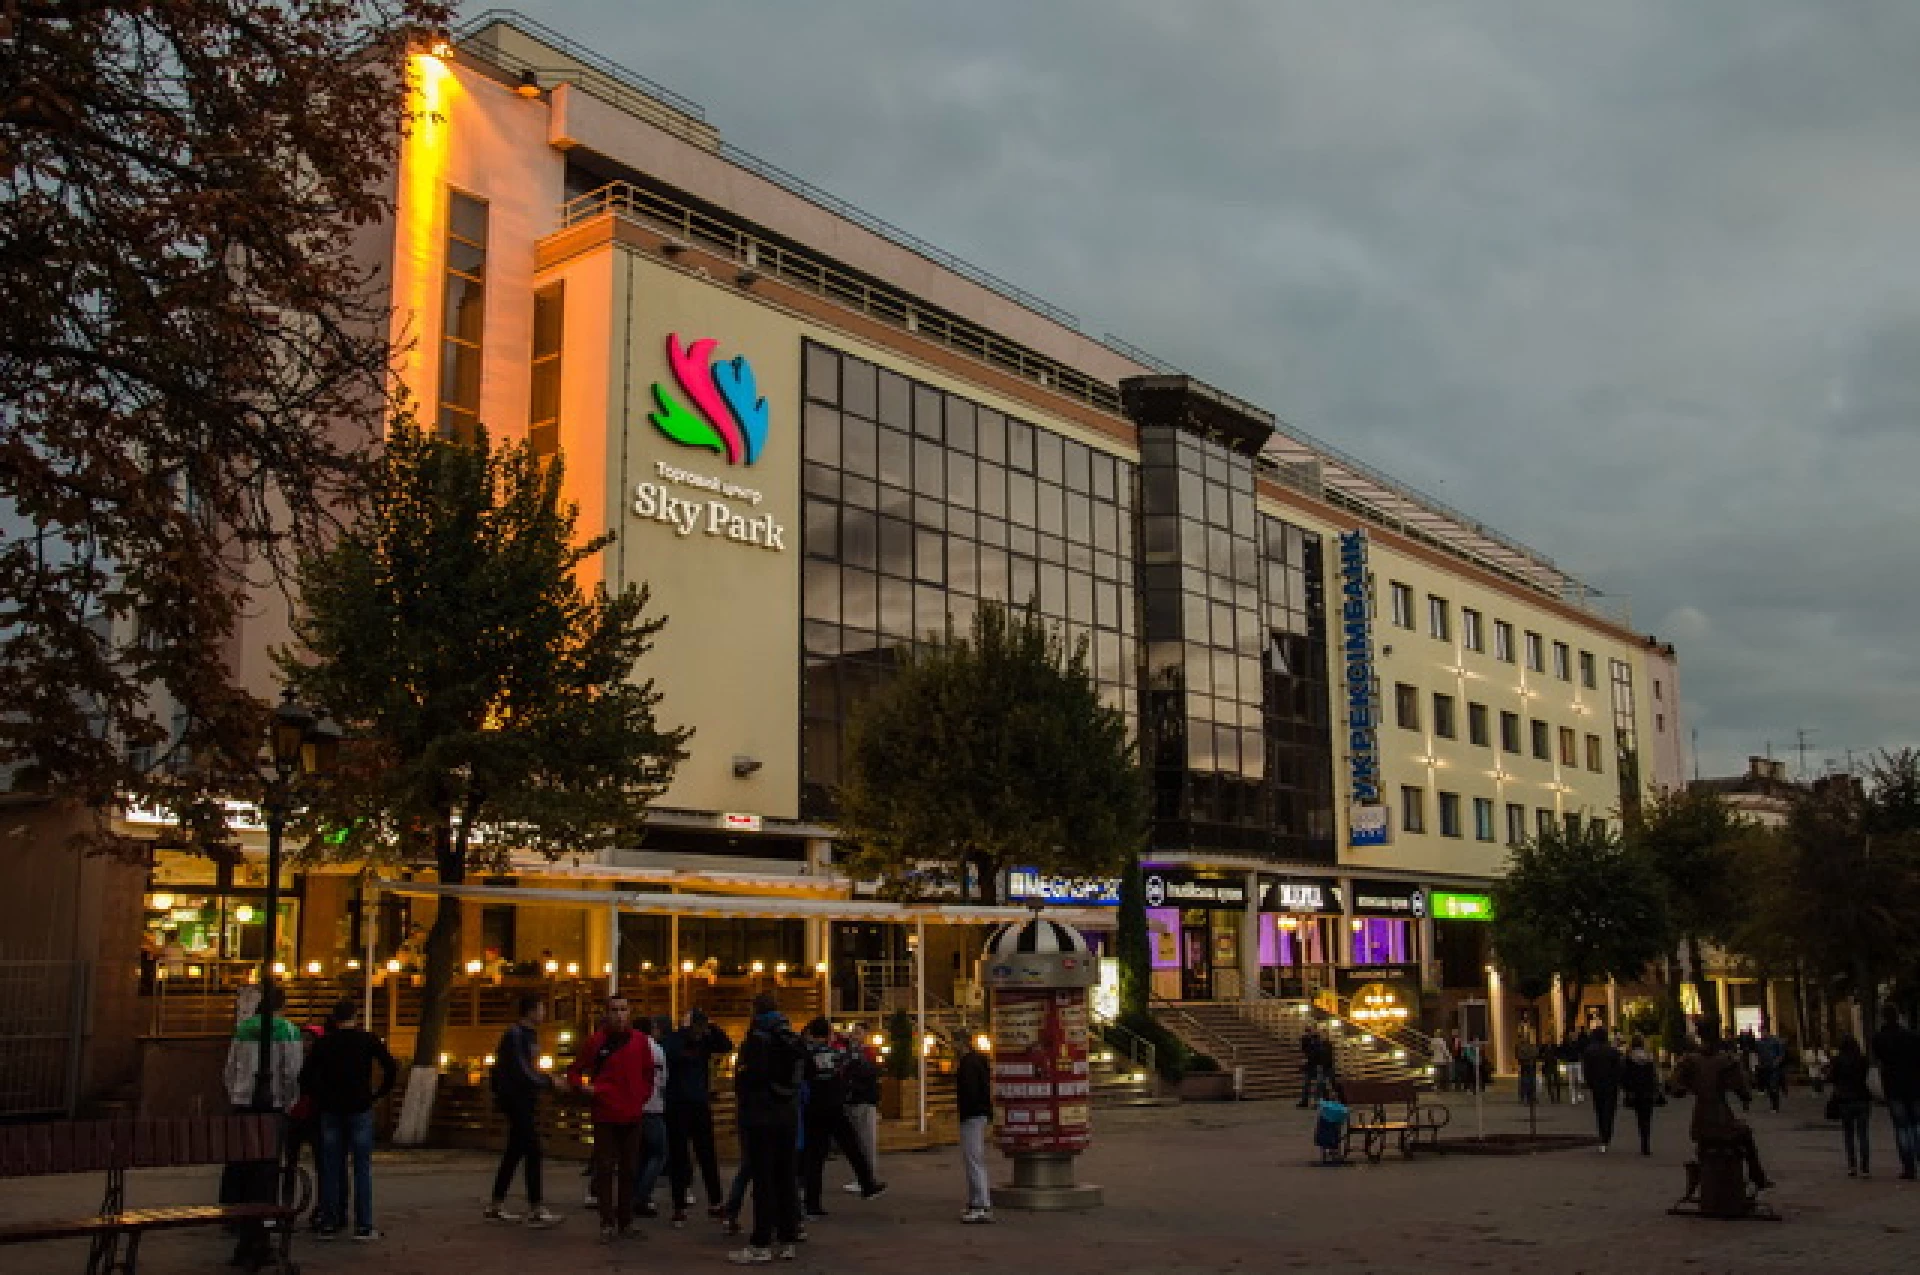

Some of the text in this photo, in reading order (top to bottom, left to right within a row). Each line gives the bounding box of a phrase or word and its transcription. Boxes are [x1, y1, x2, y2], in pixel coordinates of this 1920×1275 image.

[634, 482, 786, 550] Sky Park
[1339, 529, 1376, 803] УКРЕКСІМБАНК
